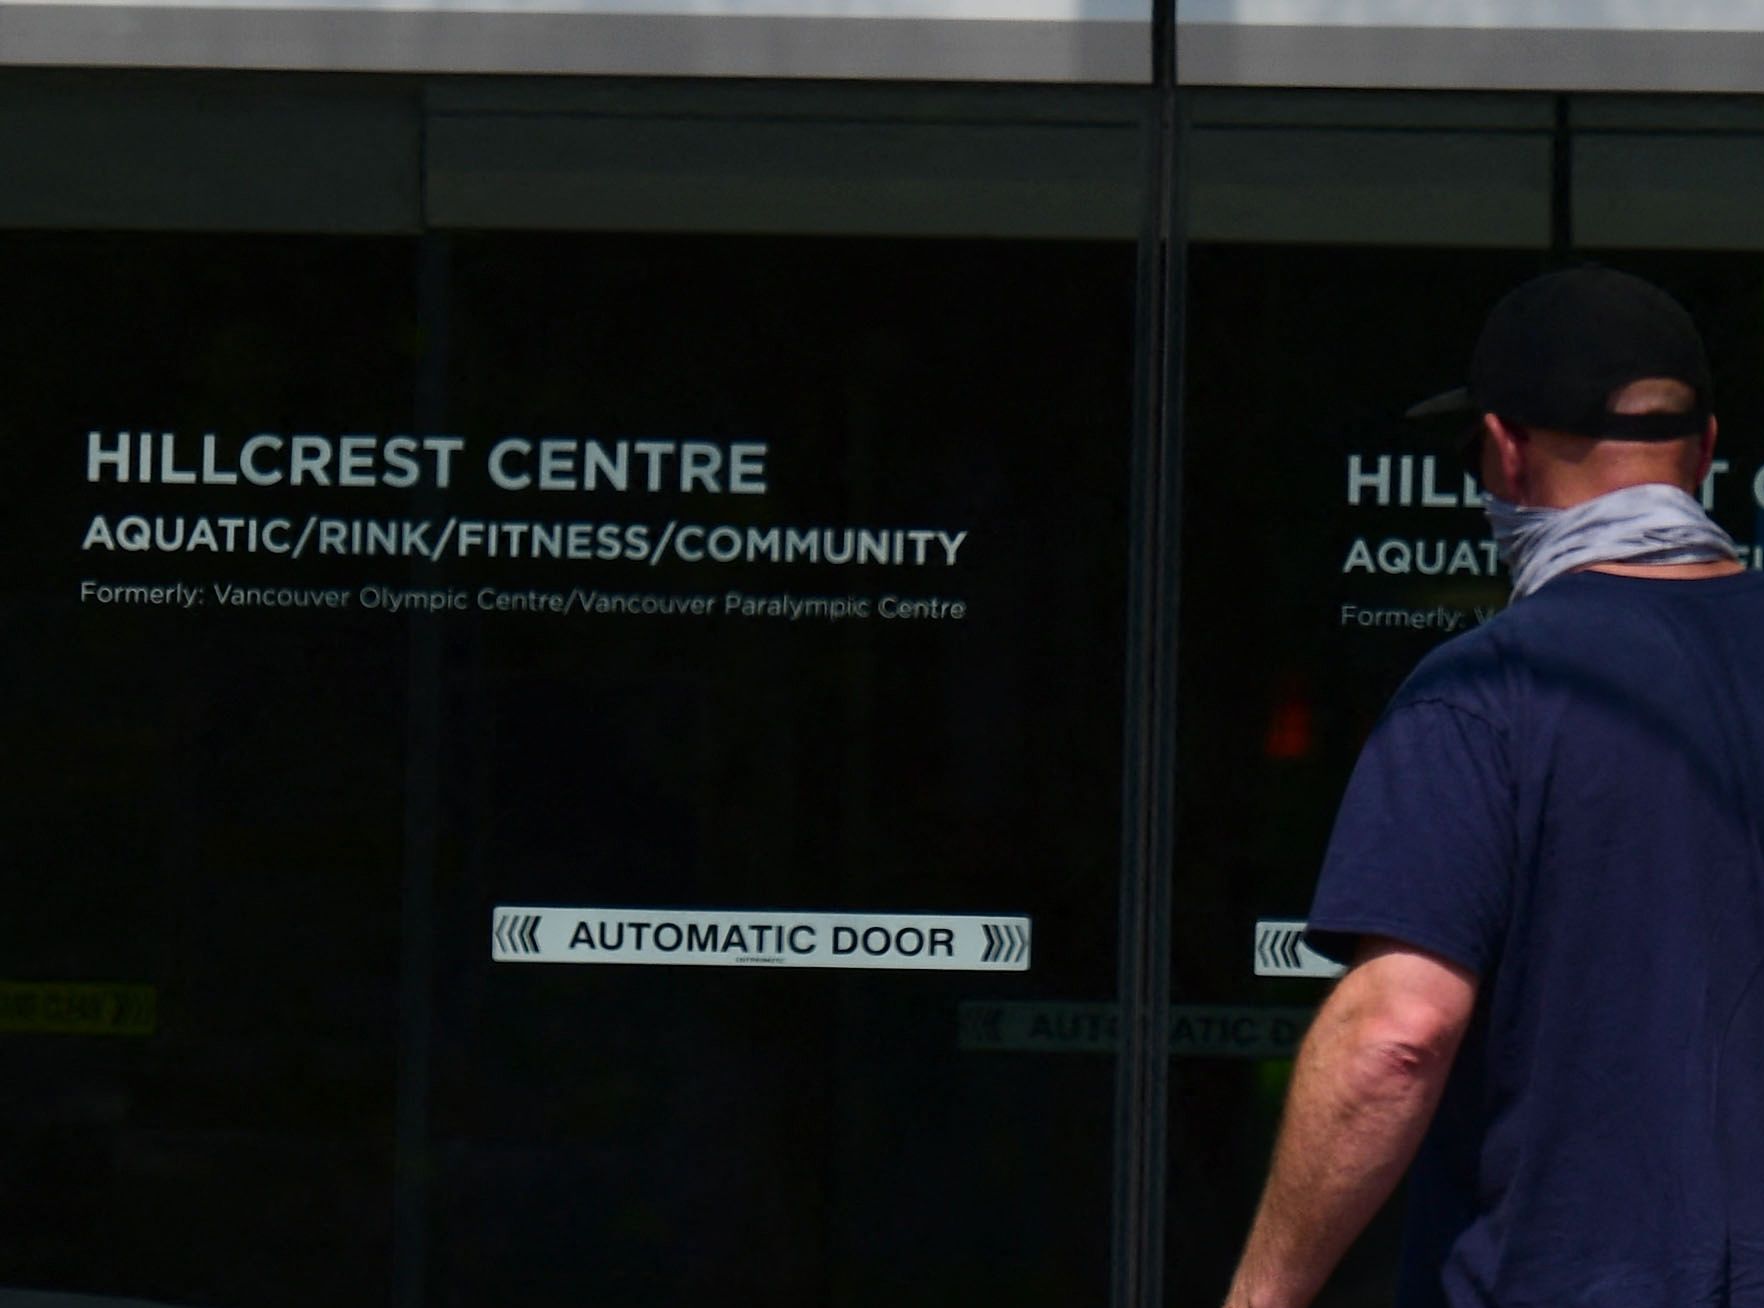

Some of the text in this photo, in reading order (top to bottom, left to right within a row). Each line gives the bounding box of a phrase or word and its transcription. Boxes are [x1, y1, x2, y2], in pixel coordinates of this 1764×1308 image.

[86, 431, 768, 495] HILLCREST CENTRE
[81, 516, 967, 566] AQUATIC/RINK/FITNESS/COMMUNITY
[80, 582, 967, 622] Formerly: Vancouver Olympic Centre/Vancouver Paralympic Centre
[1340, 605, 1466, 632] Formerly:
[570, 920, 955, 959] AUTOMATIC DOOR
